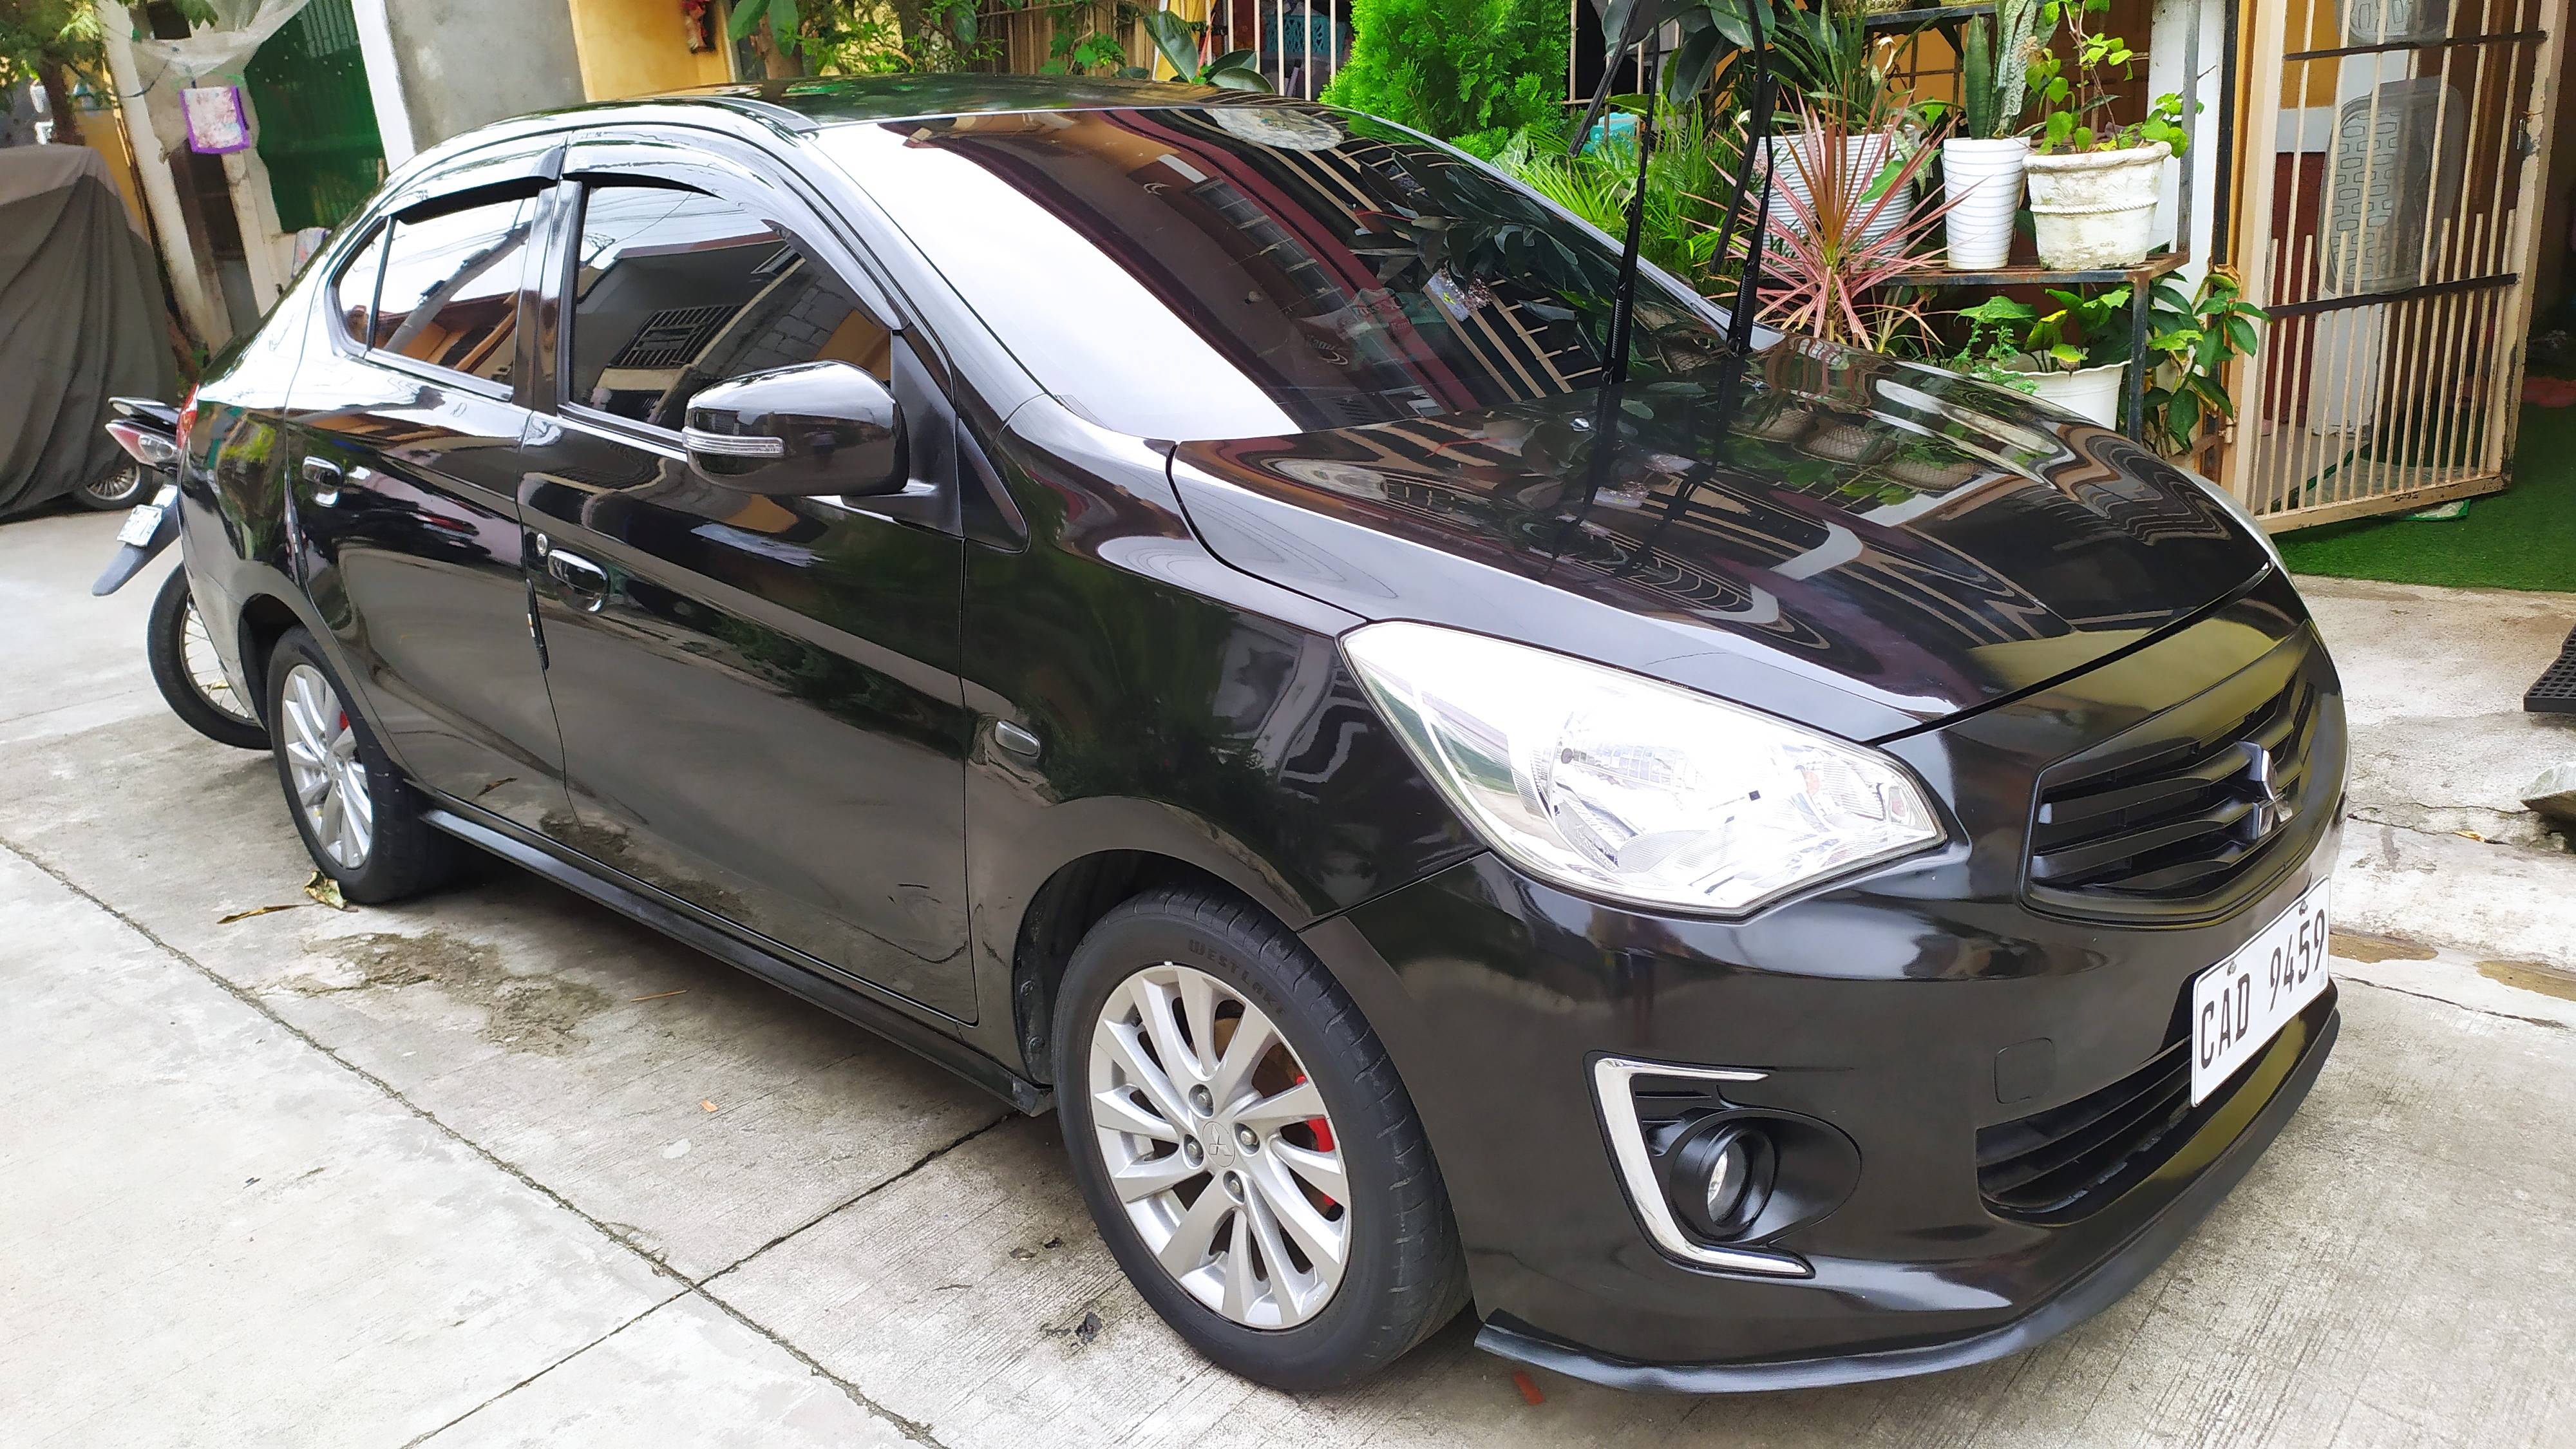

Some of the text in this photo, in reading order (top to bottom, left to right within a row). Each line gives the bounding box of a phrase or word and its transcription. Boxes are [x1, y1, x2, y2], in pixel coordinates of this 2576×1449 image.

[1189, 938, 1287, 1016] WESTLAKE
[2201, 909, 2325, 1069] CAD 9459
